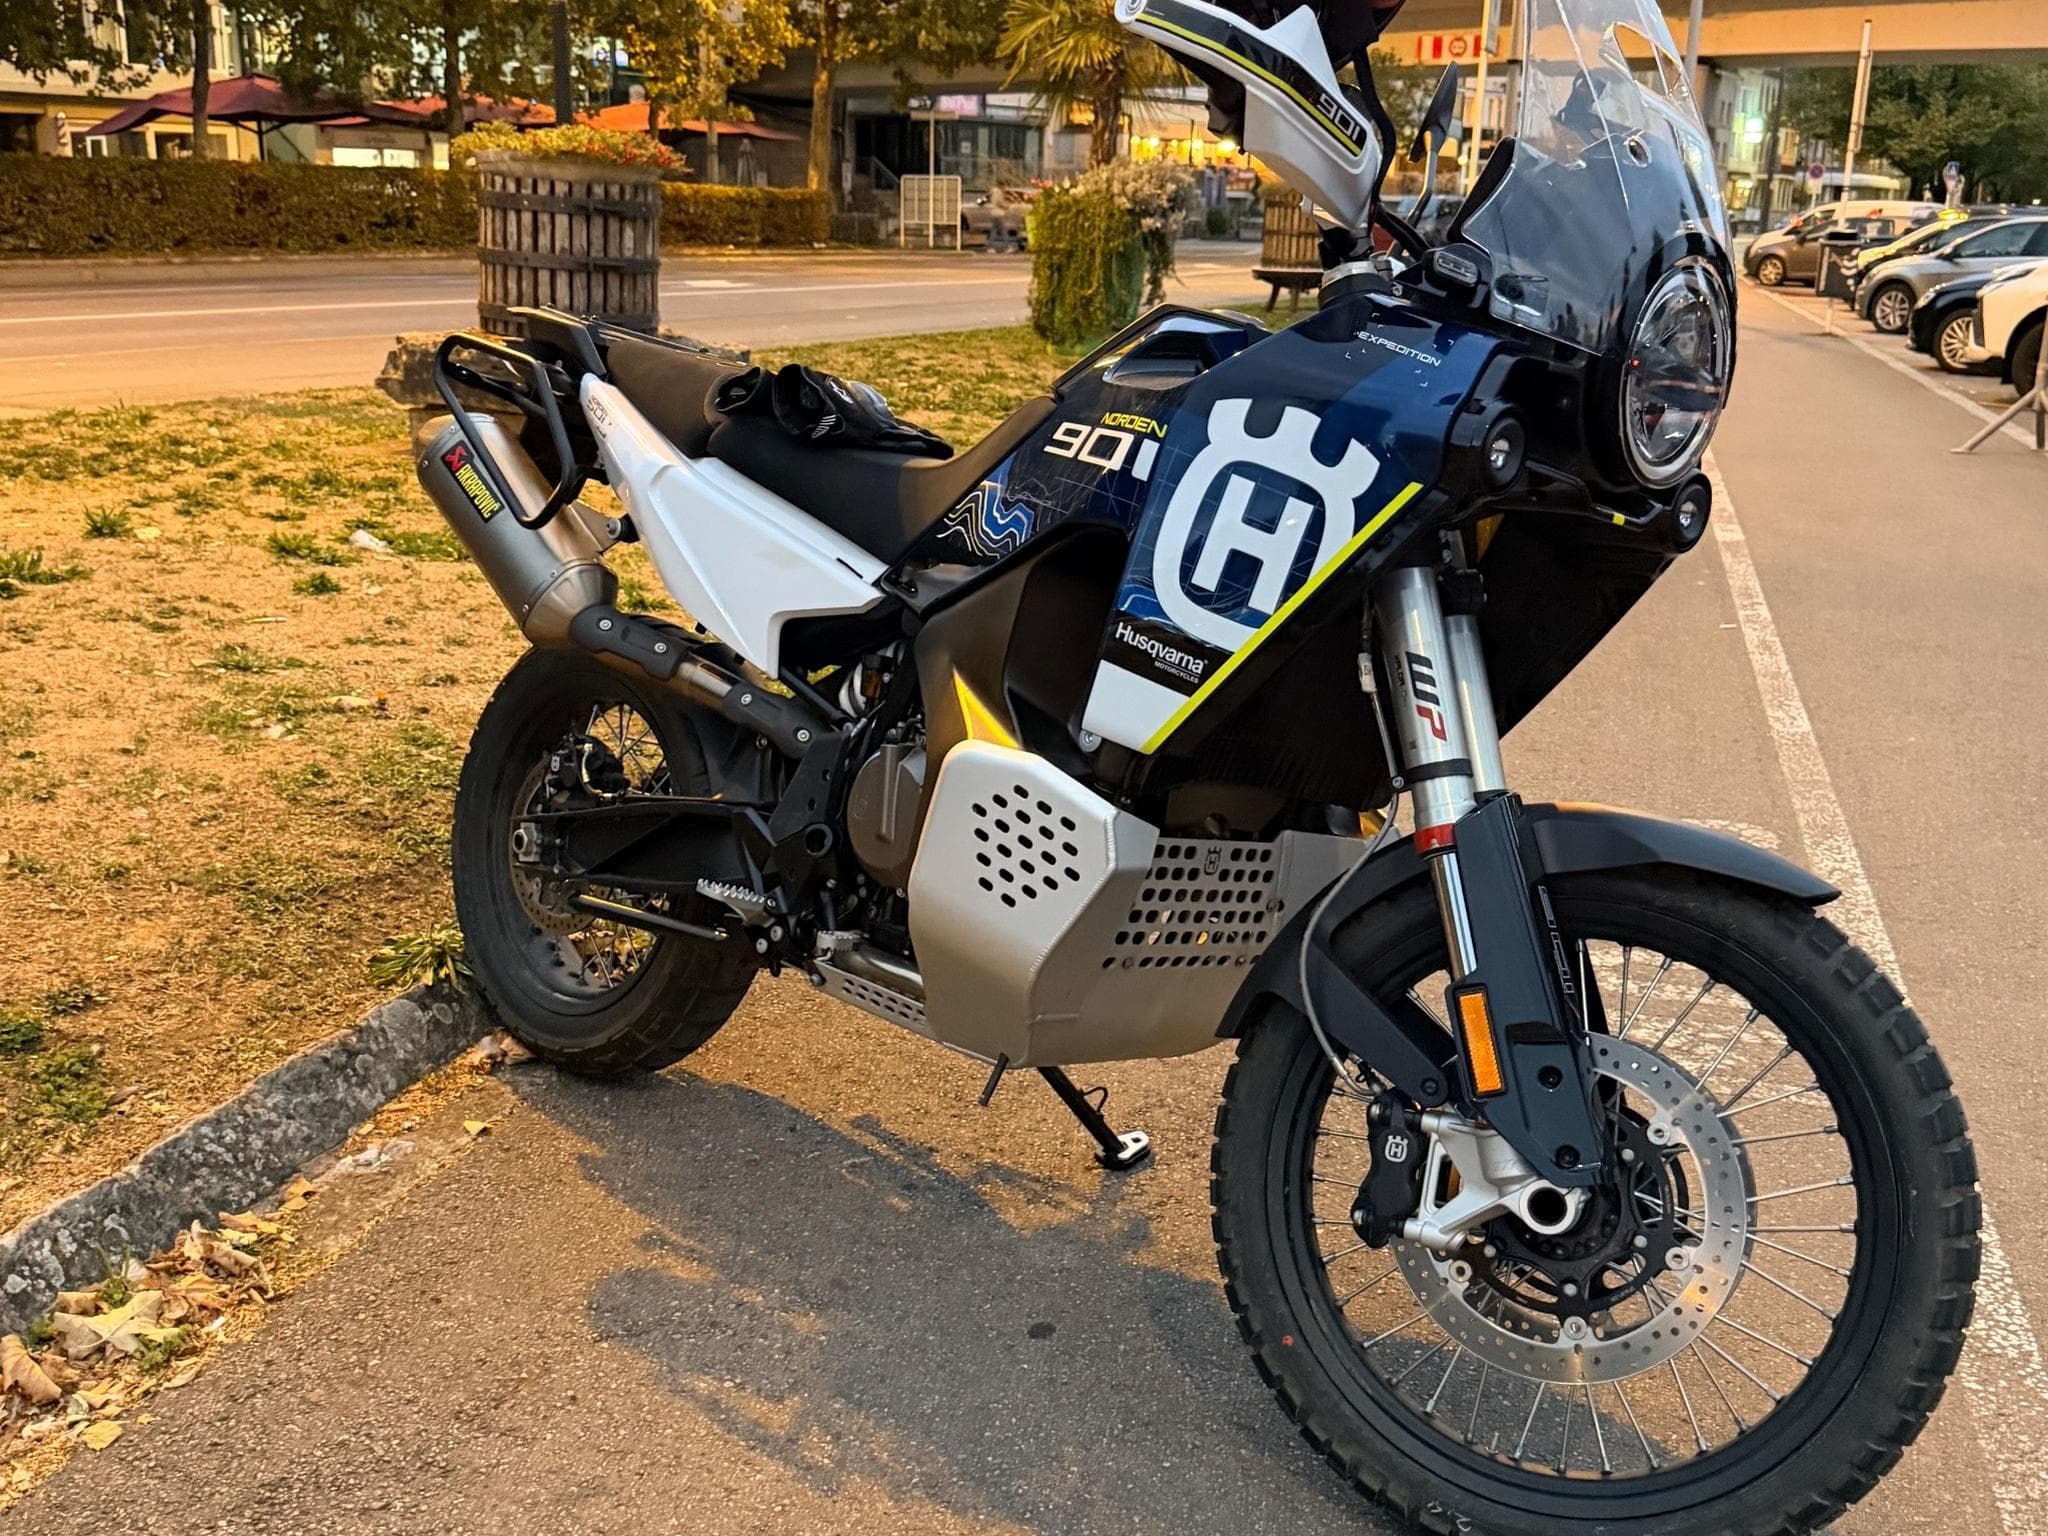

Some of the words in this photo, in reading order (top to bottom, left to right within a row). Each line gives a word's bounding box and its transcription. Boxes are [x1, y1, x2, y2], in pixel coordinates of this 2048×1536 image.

[1316, 92, 1361, 142] 901
[1357, 330, 1442, 368] EXPEDITION
[1100, 411, 1168, 439] NORDEN
[1043, 421, 1160, 482] 901
[1115, 621, 1205, 675] Husqvarna
[1154, 660, 1200, 684] MOTORCYCLES
[1405, 650, 1448, 742] WP
